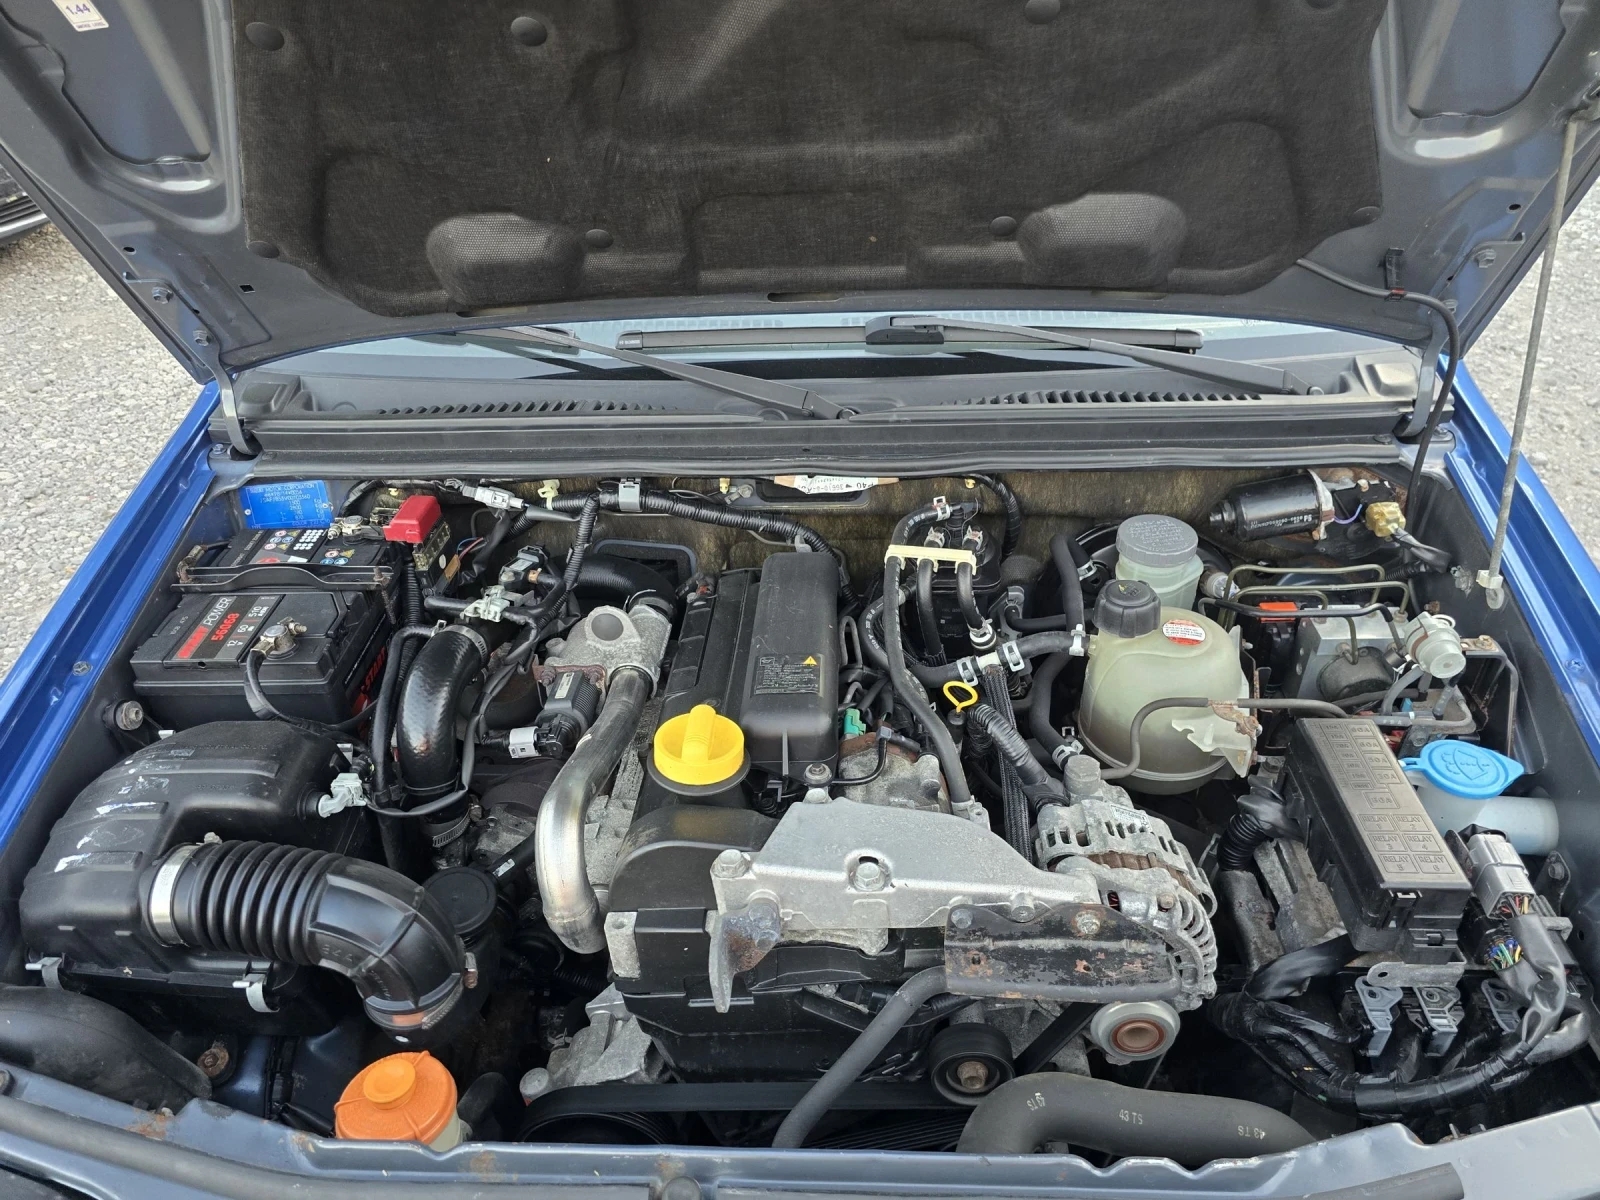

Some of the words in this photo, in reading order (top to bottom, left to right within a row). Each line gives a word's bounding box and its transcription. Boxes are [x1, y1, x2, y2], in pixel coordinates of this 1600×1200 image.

[66, 3, 91, 15] 1.44
[203, 597, 232, 626] POWER
[248, 606, 262, 617] 510
[211, 612, 240, 642] 56068
[237, 624, 249, 633] 60
[226, 640, 238, 648] 12
[1362, 815, 1389, 823] RELAY
[1409, 823, 1417, 831] 2
[1372, 835, 1399, 843] RELAY
[1406, 835, 1433, 843] RELAY
[1386, 843, 1394, 851] 3
[1421, 843, 1429, 851] 4
[1382, 855, 1410, 863] RELAY
[1417, 856, 1445, 864] RELAY
[1396, 864, 1405, 872] 5
[1432, 864, 1441, 872] 6
[1118, 1108, 1130, 1122] 43
[1131, 1111, 1144, 1126] TS
[1237, 1125, 1251, 1138] TS
[1253, 1127, 1267, 1140] 43
